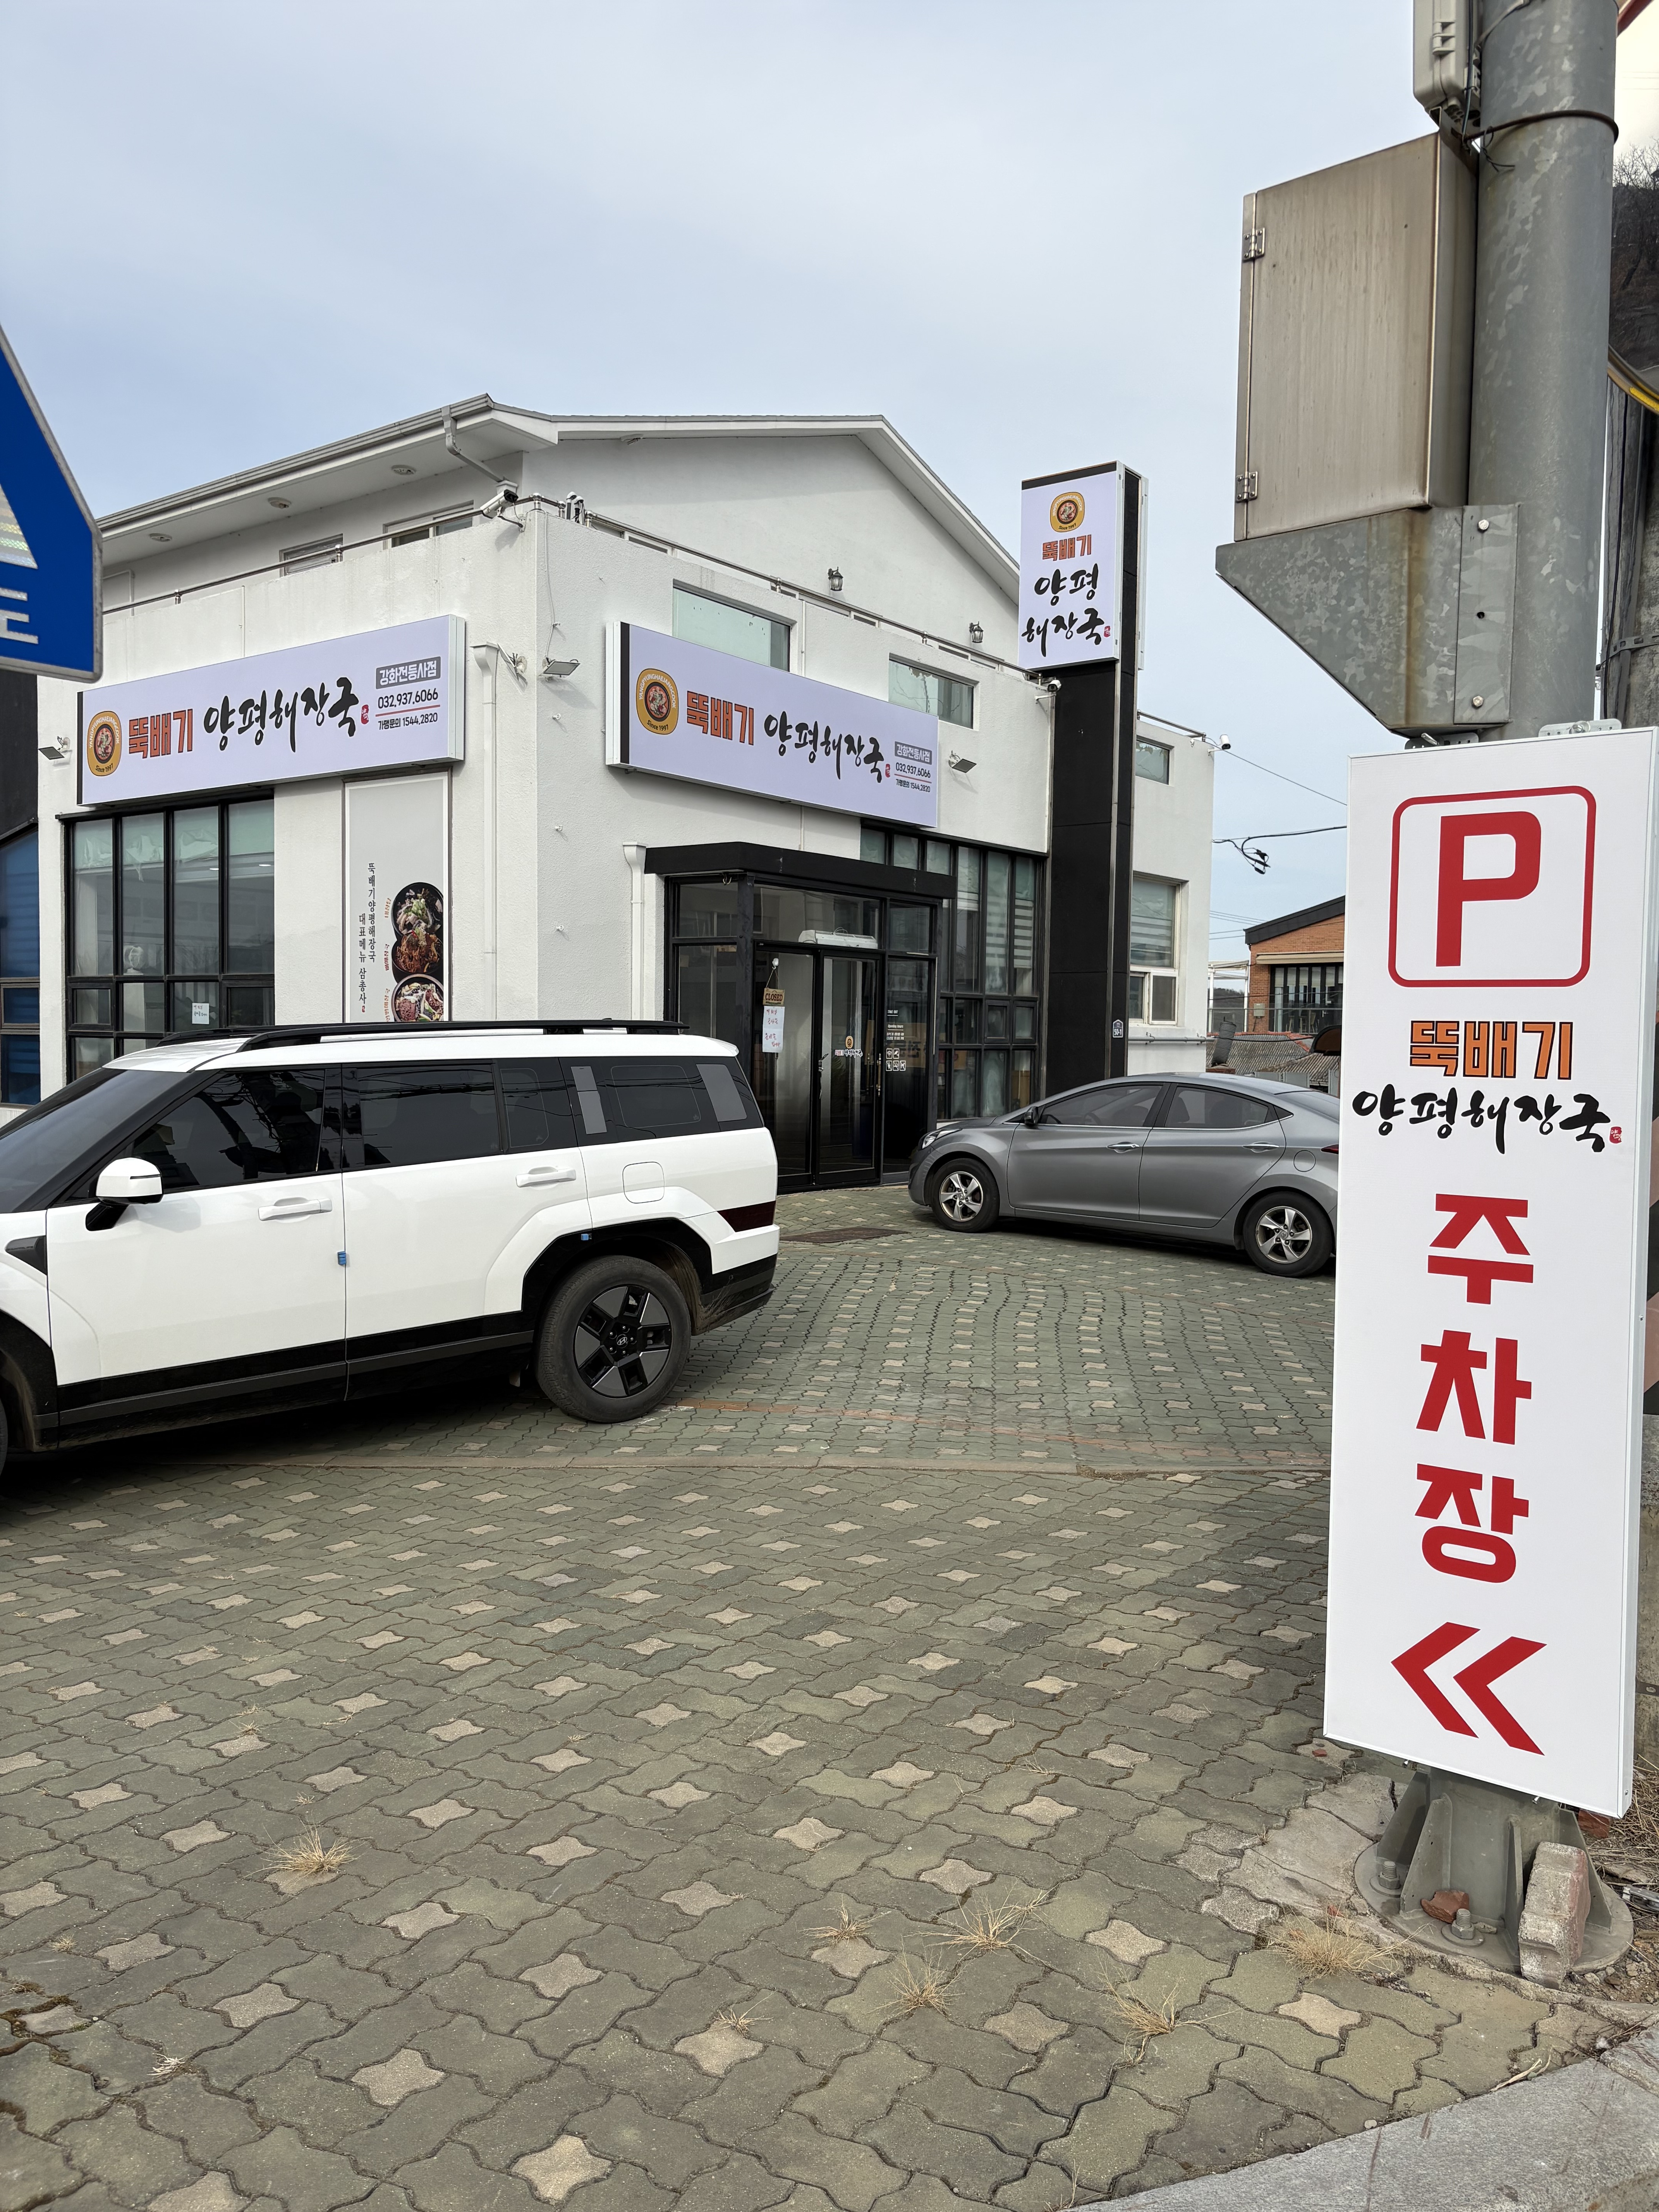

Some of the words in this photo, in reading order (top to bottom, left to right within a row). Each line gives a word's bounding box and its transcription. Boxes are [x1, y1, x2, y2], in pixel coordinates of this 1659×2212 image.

[1042, 534, 1091, 561] 뚝배기
[1034, 563, 1098, 606] 양평
[1021, 608, 1105, 657] 해장국
[379, 660, 437, 686] 강화전등사점
[639, 673, 676, 709] YANGPYUNGHAEJANGCOOK
[378, 688, 438, 709] 032.937.6066
[129, 708, 193, 759] 뚝배기
[204, 677, 359, 753] 양평해장국
[378, 718, 401, 730] 가맹문의
[402, 712, 438, 726] 1544.2820
[647, 719, 658, 730] Since
[687, 690, 754, 746] 뚝배기
[764, 711, 884, 783] 양평해장국
[896, 744, 930, 763] 강화전등사점
[895, 762, 931, 778] 032.937.6066
[896, 778, 910, 788] 가맹문의
[910, 782, 931, 793] 1544.2820
[1436, 811, 1541, 967] P
[359, 913, 367, 963] 대표메뉴
[358, 968, 367, 1005] 삼총사
[765, 993, 783, 1001] CLOSED
[1410, 1020, 1573, 1080] 뚝배기
[1352, 1084, 1611, 1154] 양평해장국
[1415, 1194, 1534, 1583] 주차장
